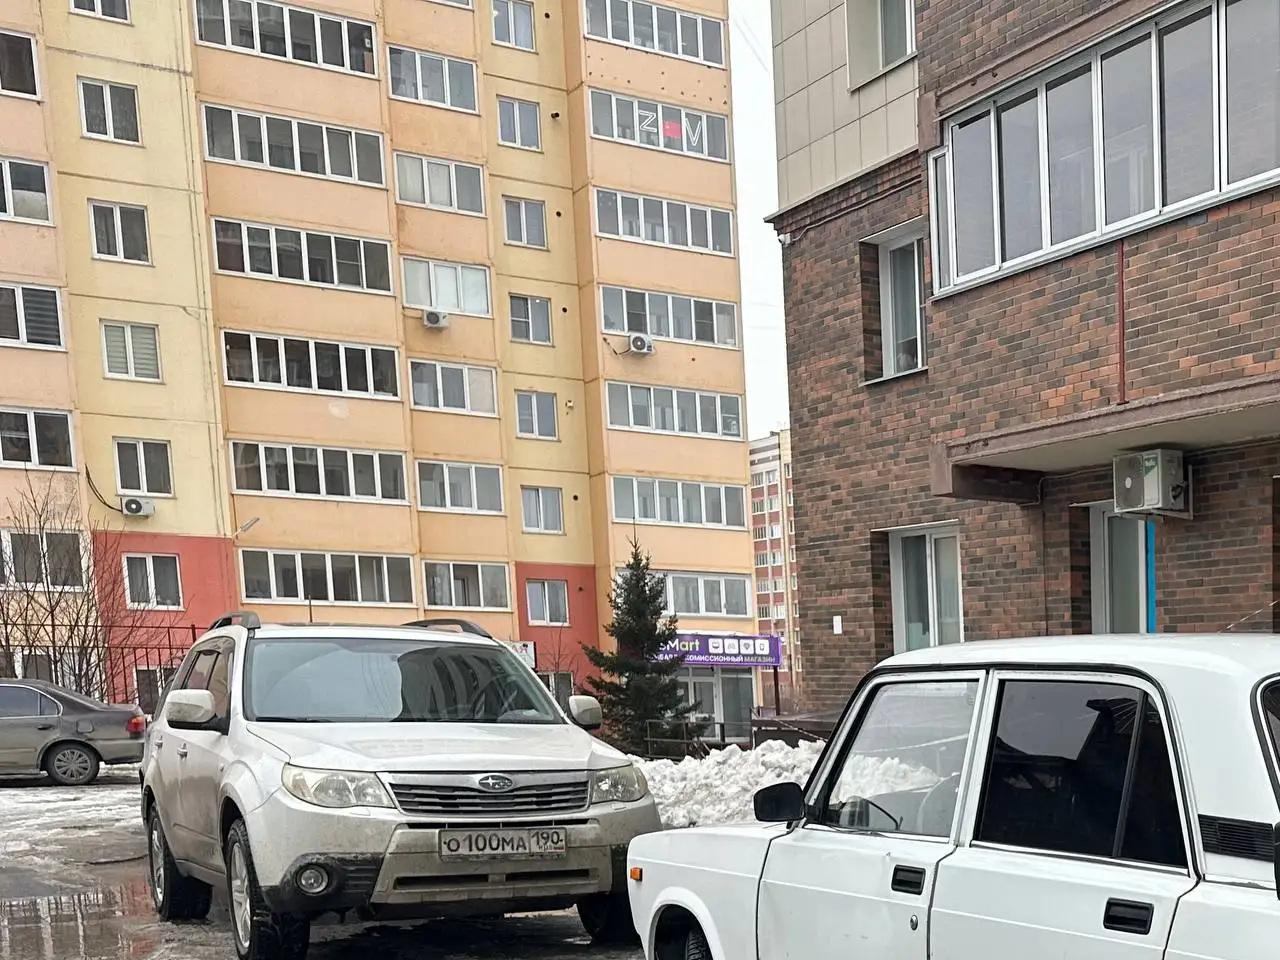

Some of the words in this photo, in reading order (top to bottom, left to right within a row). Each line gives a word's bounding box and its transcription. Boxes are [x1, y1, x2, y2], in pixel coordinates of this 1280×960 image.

[638, 109, 658, 133] Z
[684, 117, 702, 146] V
[658, 638, 701, 652] sMart
